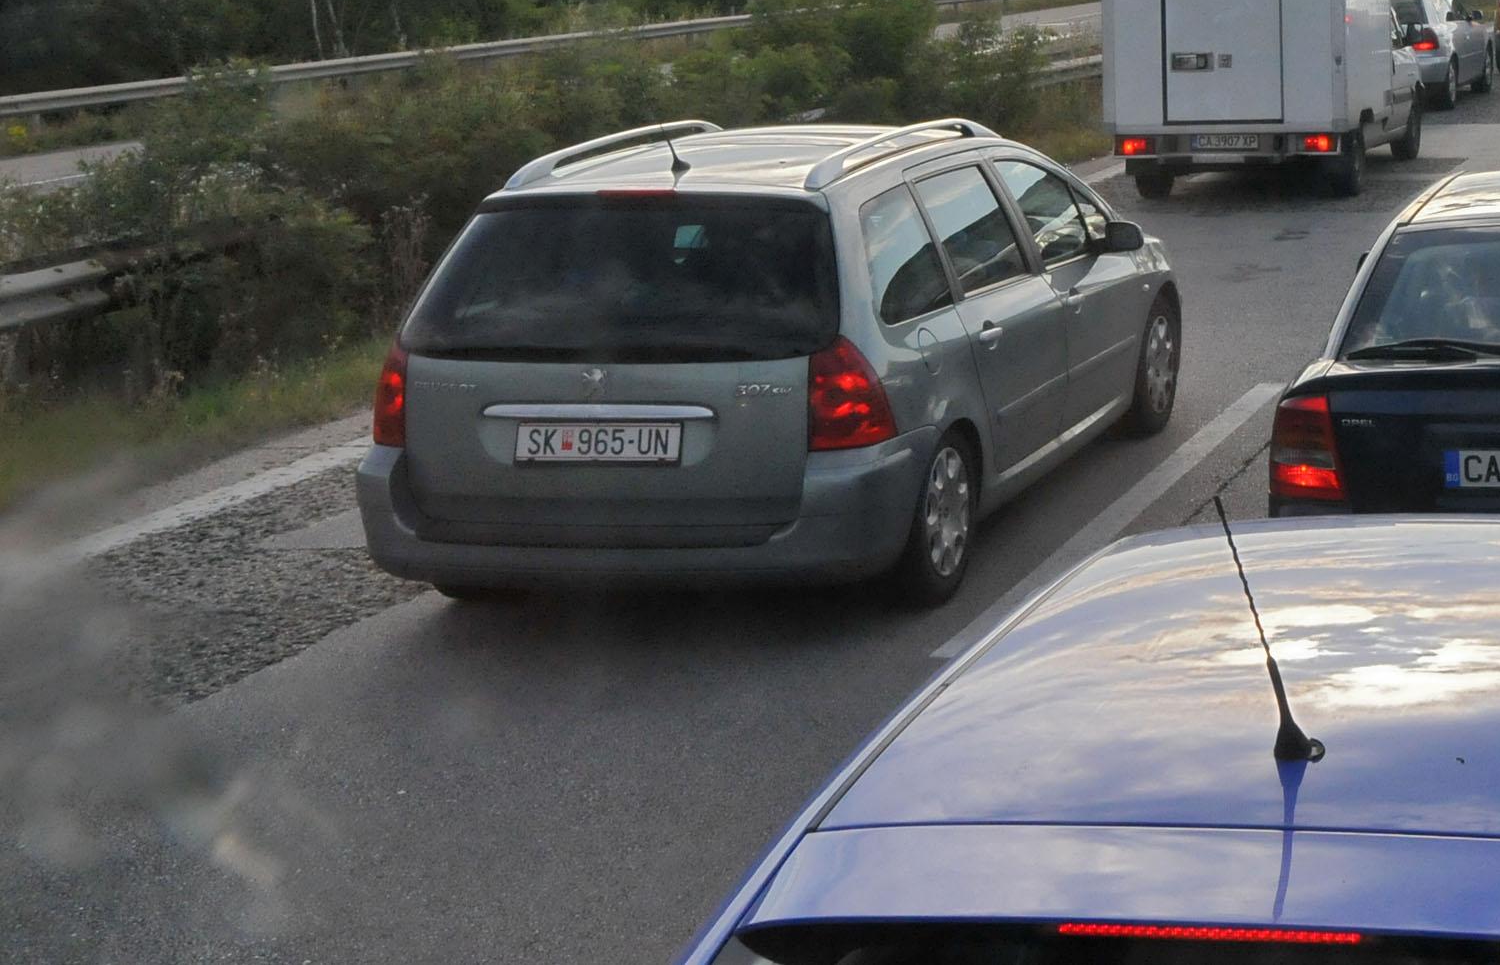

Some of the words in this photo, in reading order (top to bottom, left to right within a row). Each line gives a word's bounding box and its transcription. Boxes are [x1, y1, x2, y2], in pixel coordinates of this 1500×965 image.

[1199, 136, 1213, 147] CA
[528, 429, 557, 455] SK
[577, 429, 670, 455] 965-UN
[1464, 455, 1500, 483] CA
